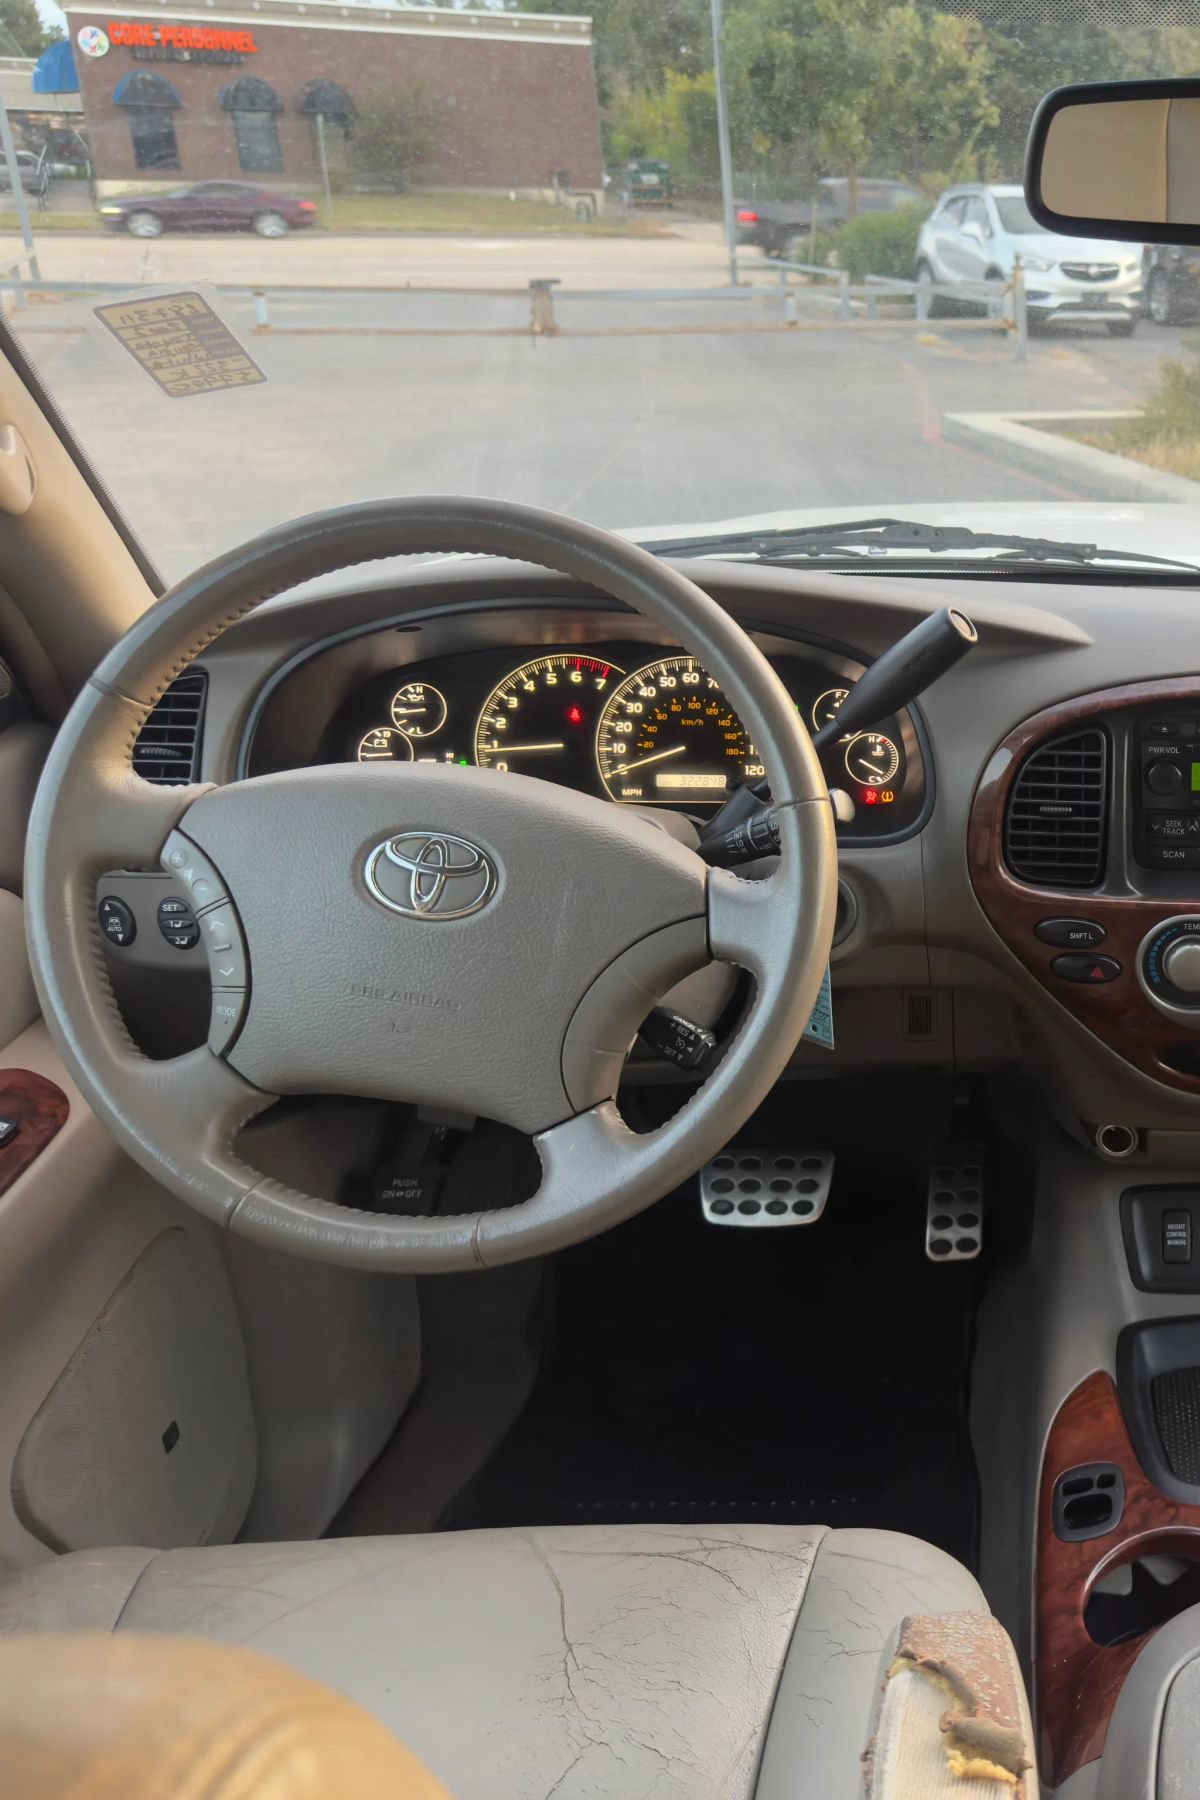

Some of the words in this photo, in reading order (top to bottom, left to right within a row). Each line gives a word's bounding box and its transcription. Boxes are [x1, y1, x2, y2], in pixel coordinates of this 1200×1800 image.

[159, 25, 258, 53] PERSONNEL
[546, 673, 558, 684] 5
[571, 671, 583, 682] 6
[659, 676, 677, 688] 50
[682, 672, 700, 684] 60
[524, 681, 536, 692] 4
[595, 678, 606, 690] 7
[415, 686, 424, 694] H
[639, 686, 657, 697] 40
[835, 691, 843, 699] F
[507, 697, 519, 708] 3
[626, 702, 643, 714] 30
[671, 704, 682, 712] 80
[687, 702, 701, 710] 100
[495, 717, 507, 729] 2
[615, 721, 633, 733] 20
[681, 718, 704, 726] km/h
[718, 719, 731, 727] 140
[416, 727, 424, 735] L
[647, 725, 658, 733] 40
[492, 740, 499, 749] 1
[612, 743, 627, 754] 10
[745, 765, 765, 776] 120
[621, 788, 642, 796] MPH
[1162, 828, 1185, 836] TRACK
[1162, 850, 1185, 859] SCAN
[162, 903, 178, 912] SET
[1069, 932, 1087, 940] SHIFT
[216, 1006, 237, 1017] MODE
[677, 1025, 690, 1037] RES
[392, 1178, 419, 1188] PUSH
